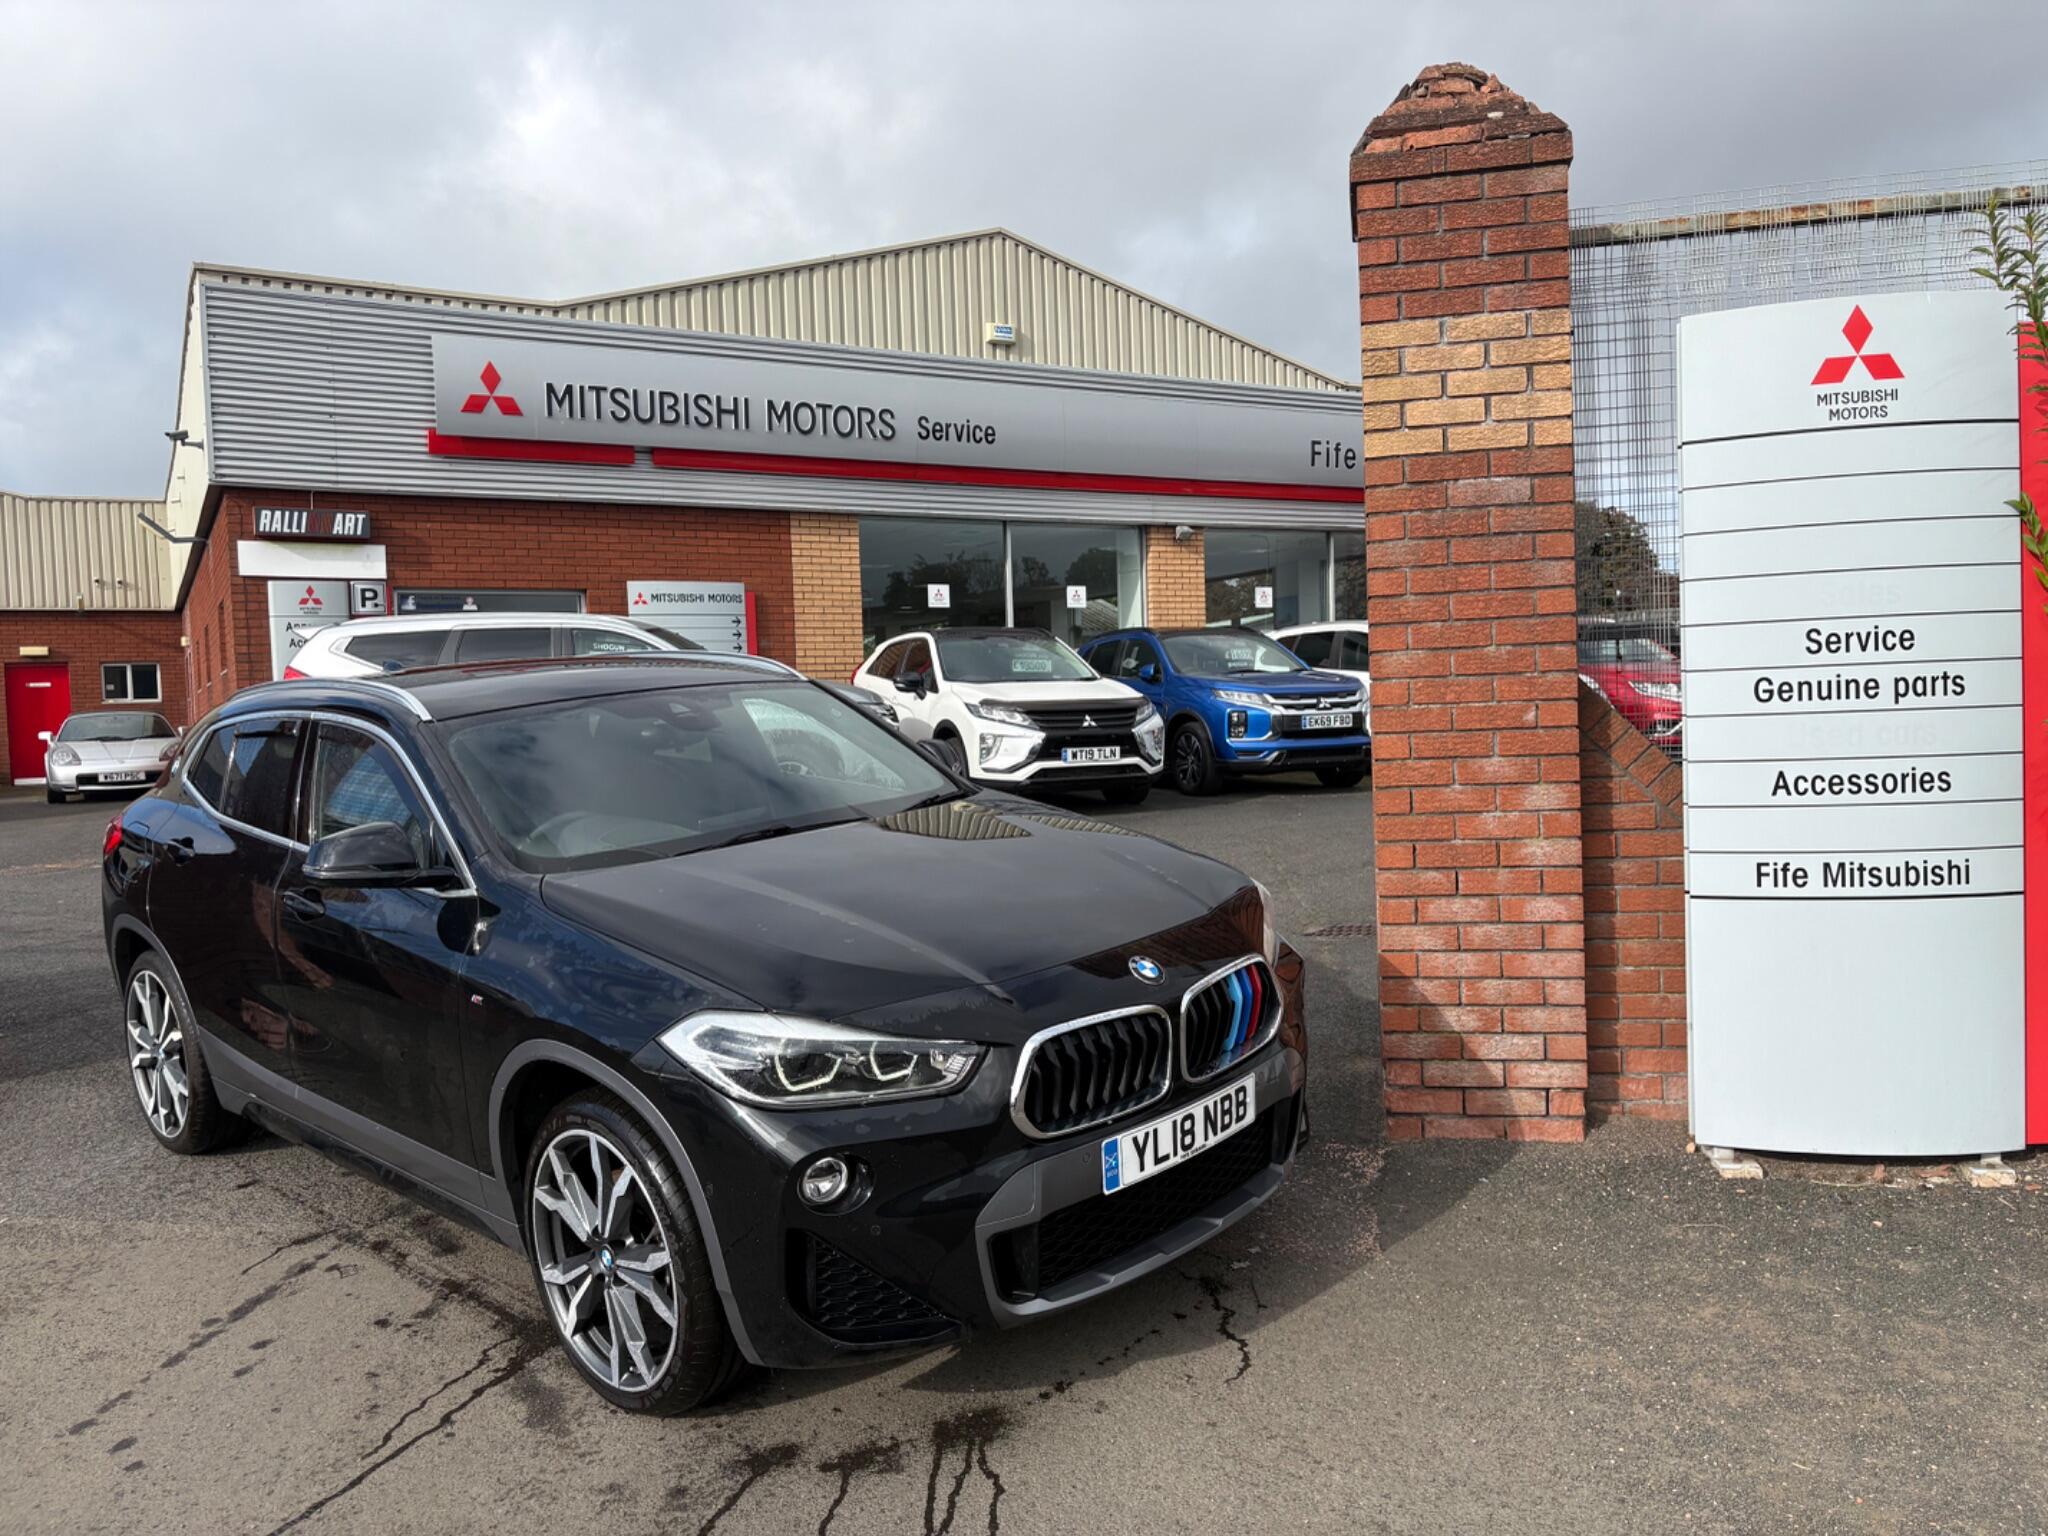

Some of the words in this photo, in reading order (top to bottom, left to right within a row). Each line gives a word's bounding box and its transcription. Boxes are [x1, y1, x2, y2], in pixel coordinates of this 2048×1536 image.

[1816, 388, 1899, 407] MITSUBISHI
[546, 382, 750, 431] MITSUBISHI
[767, 399, 897, 443] MOTORS
[917, 415, 997, 445] Service
[1828, 405, 1889, 421] MOTORS
[1310, 440, 1356, 470] Fife
[650, 593, 704, 604] MITSUBISHI
[708, 593, 743, 604] MOTORS
[1805, 625, 1915, 655] Service
[1753, 673, 1881, 703] Genuine
[1894, 670, 1966, 705] parts
[1070, 748, 1095, 761] WT19
[1096, 747, 1117, 760] TLN
[1771, 766, 1952, 797] Accessories
[1756, 861, 1809, 889] Fife
[1822, 858, 1971, 888] Mitsubishi
[1132, 1113, 1196, 1173] YL18
[1204, 1085, 1248, 1142] NBB
